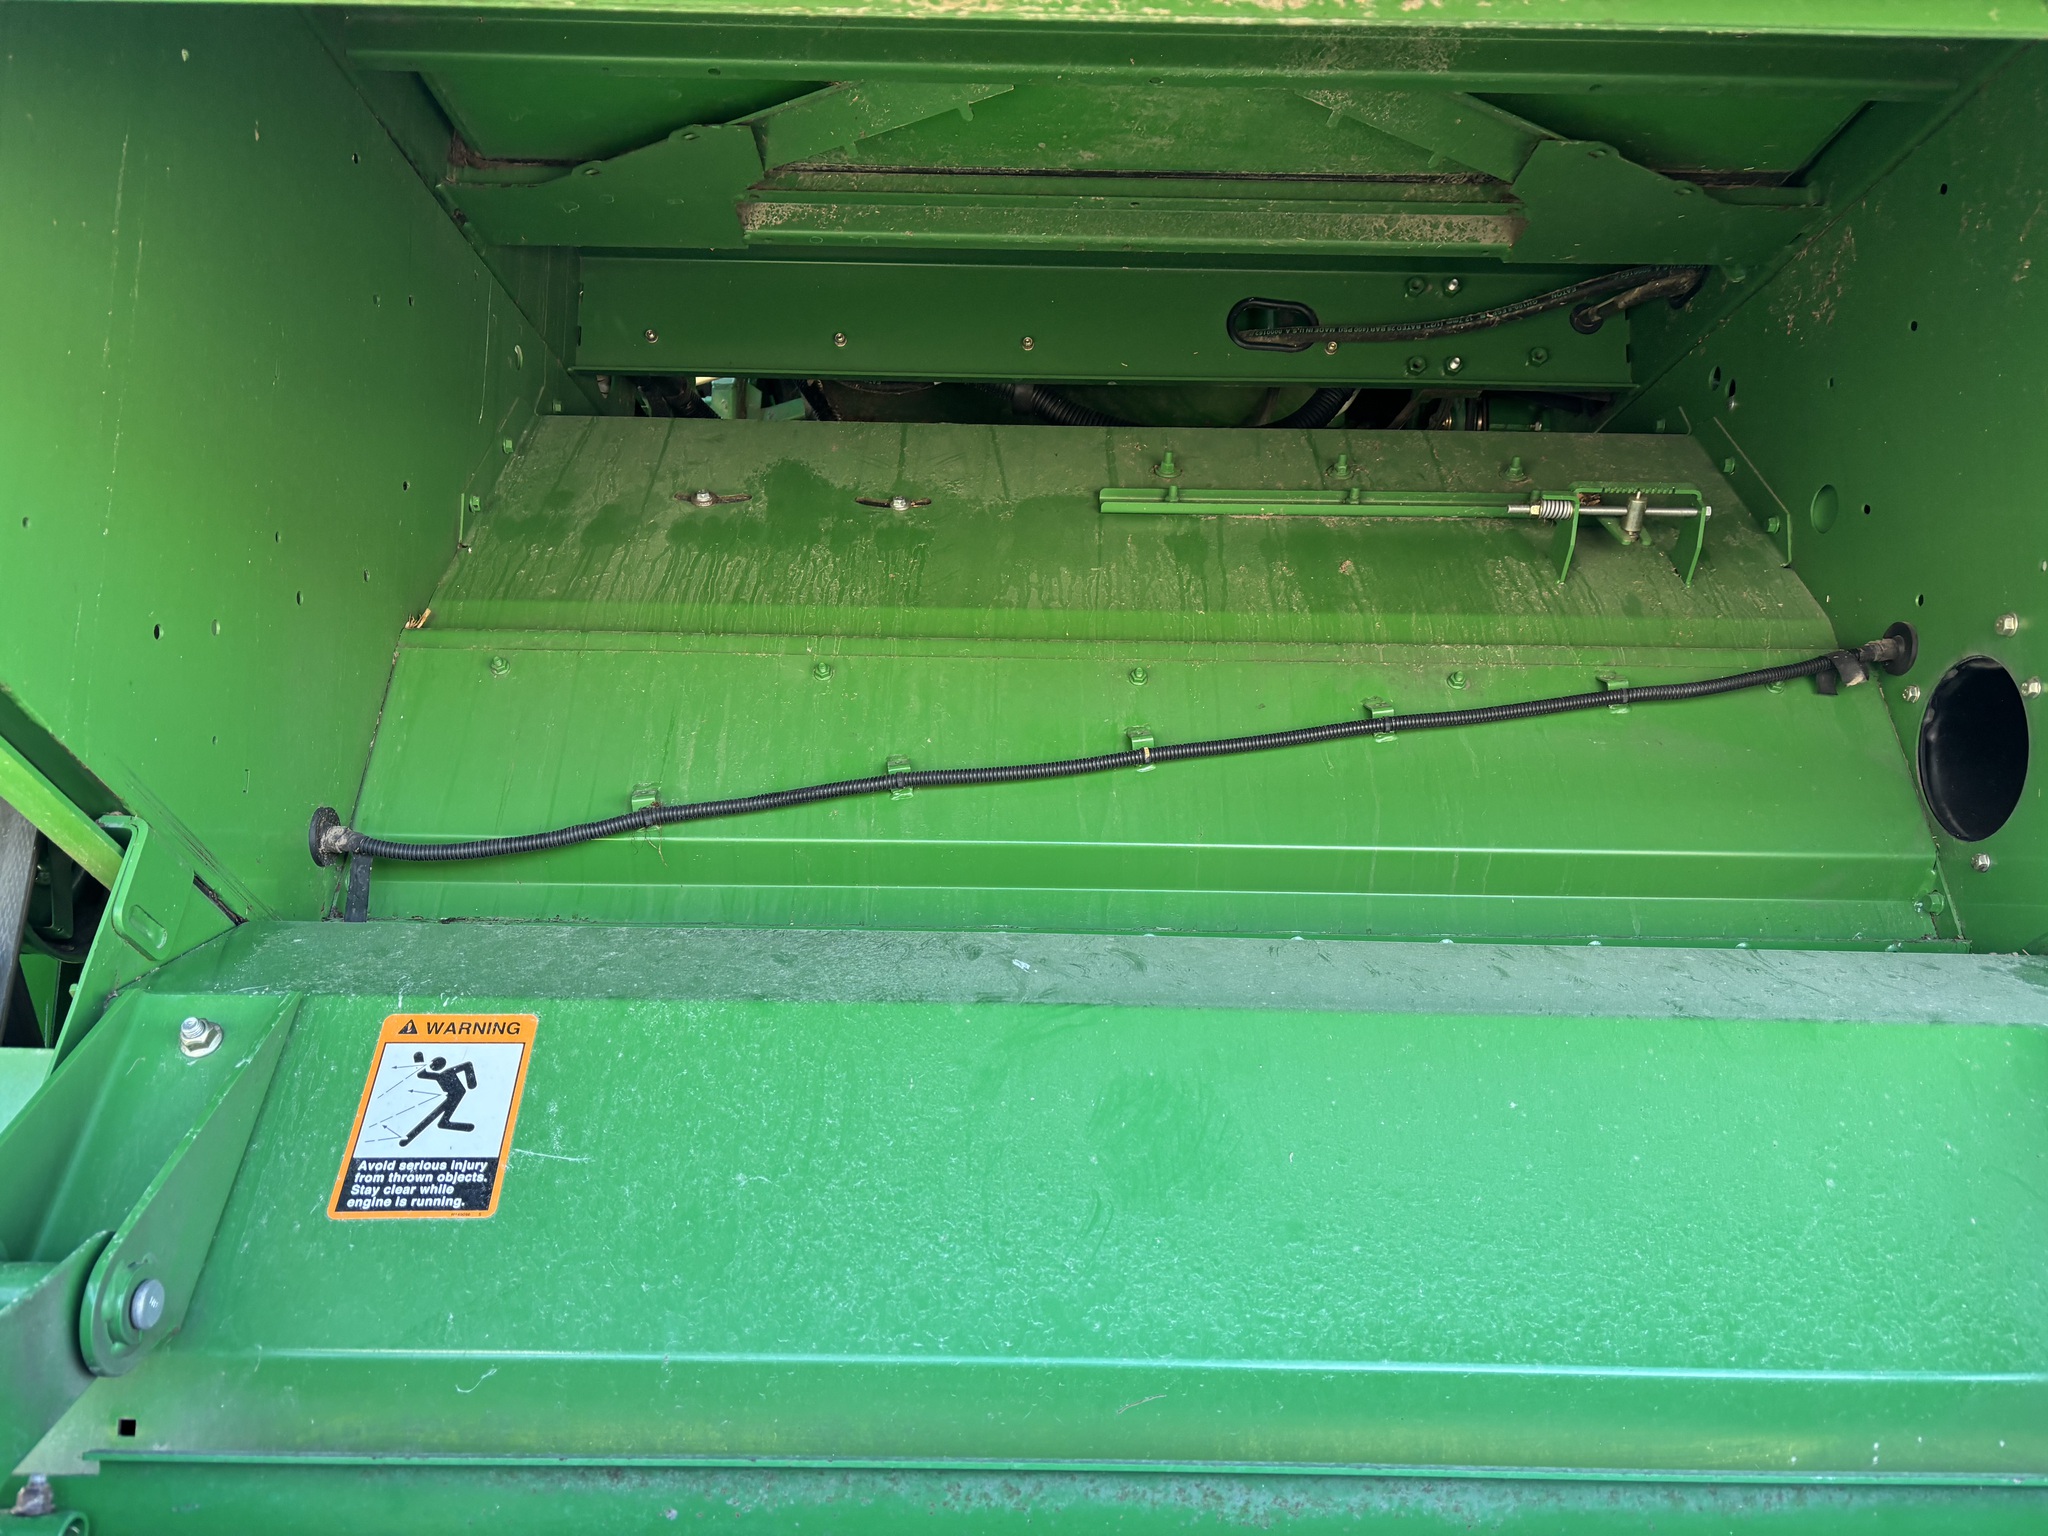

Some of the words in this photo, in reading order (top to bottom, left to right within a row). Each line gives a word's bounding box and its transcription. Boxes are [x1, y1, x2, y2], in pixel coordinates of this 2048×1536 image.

[1551, 286, 1578, 299] EATON
[1396, 323, 1422, 331] RATED
[426, 1022, 520, 1035] WARNING
[358, 1161, 396, 1171] Avoid
[399, 1161, 447, 1171] serious
[451, 1161, 488, 1173] injury
[355, 1173, 384, 1183] from
[388, 1173, 434, 1183] thrown
[437, 1173, 487, 1184] objects.
[351, 1185, 380, 1196] Stay
[383, 1185, 415, 1194] clear
[420, 1185, 454, 1194] while
[347, 1197, 392, 1209] engine
[395, 1197, 406, 1207] is
[411, 1197, 465, 1209] running.
